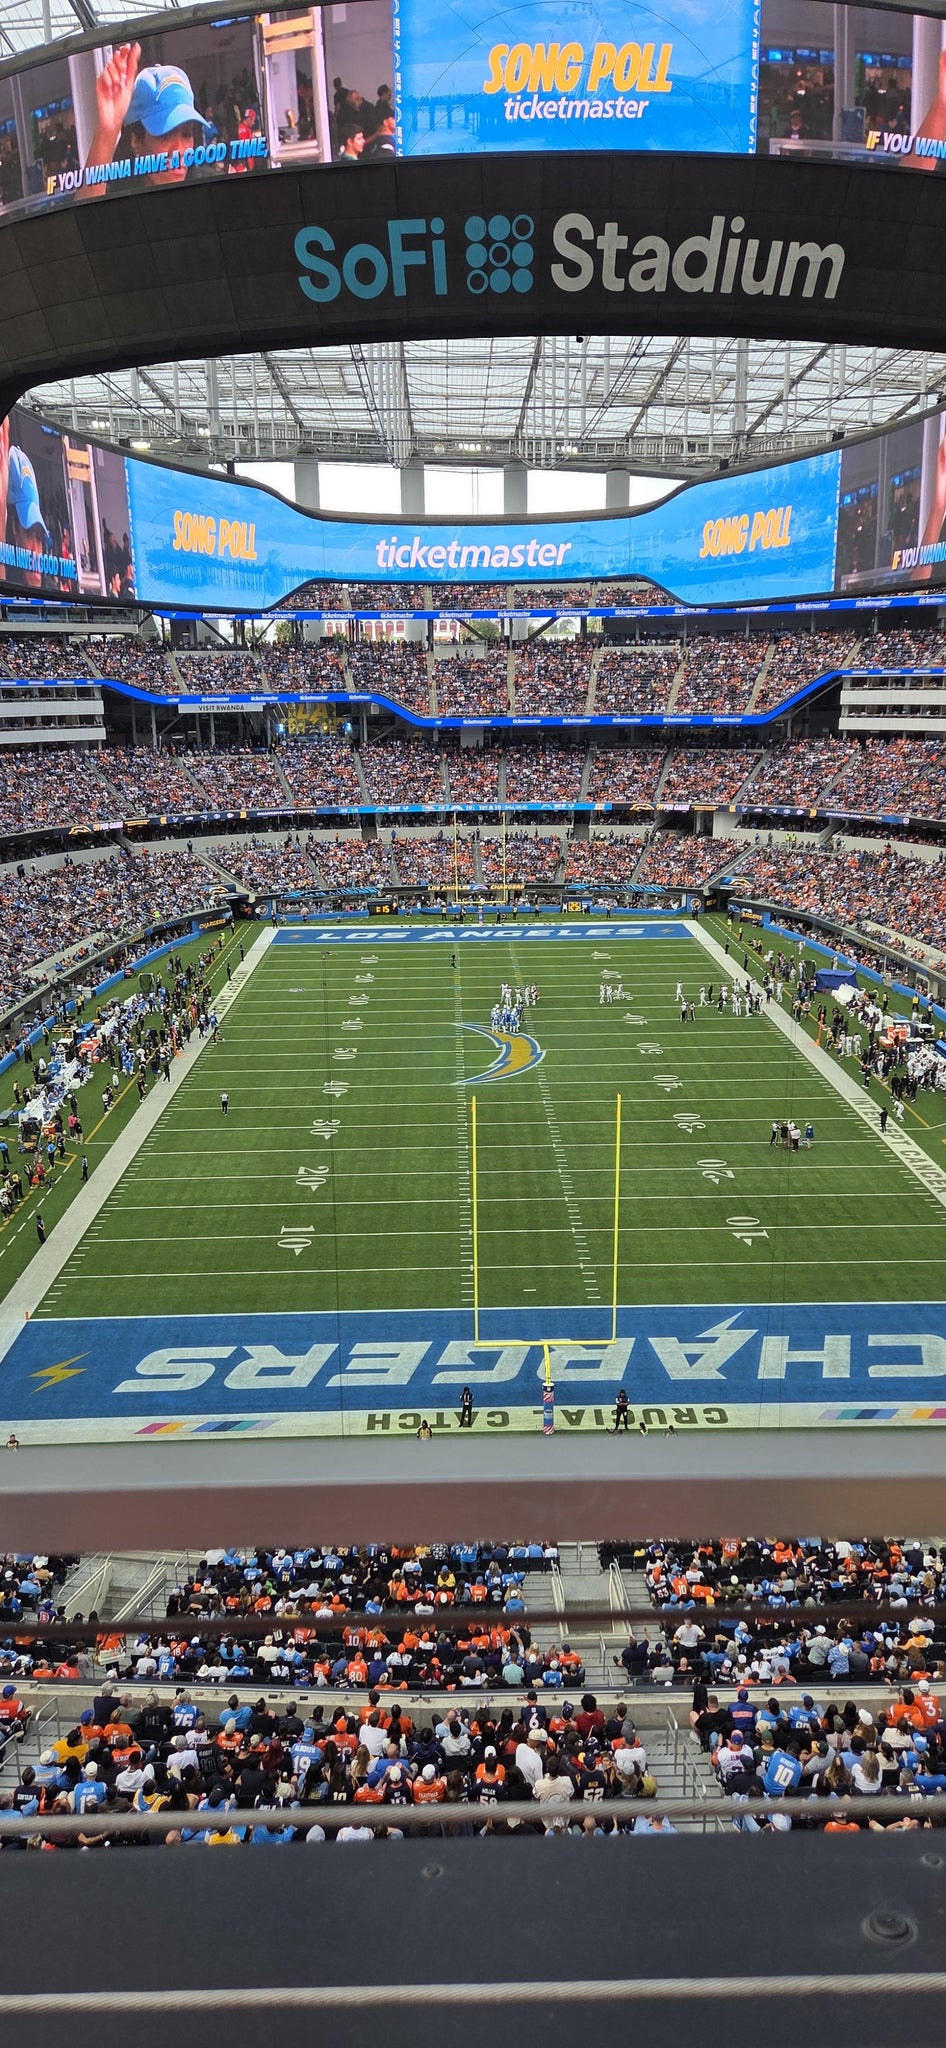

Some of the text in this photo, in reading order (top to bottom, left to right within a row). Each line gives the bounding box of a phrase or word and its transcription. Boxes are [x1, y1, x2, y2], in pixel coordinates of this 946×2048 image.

[484, 42, 673, 94] SONG POLL
[504, 94, 649, 120] ticketmaster
[866, 130, 881, 151] IF
[882, 133, 914, 153] YOU
[46, 137, 270, 195] IF YOU WANNA HAVE A GOOD TIME,
[294, 212, 846, 303] SoFi Stadium
[173, 510, 257, 560] SONG POLL
[699, 505, 793, 559] SONG POLL
[375, 536, 572, 569] ticketmaster
[892, 550, 902, 570] IF
[902, 547, 920, 569] YOU
[38, 552, 59, 576] GOOD
[200, 918, 226, 929] CHARGERS
[316, 928, 647, 941] LOS ANGELES
[332, 1048, 358, 1060] 50
[637, 1042, 663, 1054] 50
[322, 1080, 350, 1094] 40
[653, 1074, 683, 1088] 40
[310, 1119, 340, 1136] 30
[673, 1112, 706, 1131] 30
[848, 1098, 946, 1194] INTERCEPT CANCER
[296, 1166, 330, 1186] 20
[697, 1159, 736, 1180] 20
[277, 1224, 315, 1248] 10
[726, 1216, 770, 1240] 10
[112, 1311, 946, 1393] CHARGERS
[366, 1409, 510, 1430] CATCH
[724, 1542, 738, 1552] 45
[678, 1584, 687, 1595] 10
[874, 1588, 882, 1600] 7
[274, 1629, 283, 1642] 10
[348, 1635, 360, 1646] 10
[161, 1662, 169, 1672] 10
[350, 1671, 362, 1682] 80
[924, 1701, 936, 1716] 3
[174, 1714, 194, 1727] 76
[529, 1713, 539, 1728] 6
[293, 1756, 311, 1774] 19
[774, 1765, 794, 1787] 10
[333, 1792, 348, 1800] 10
[583, 1788, 604, 1802] 52
